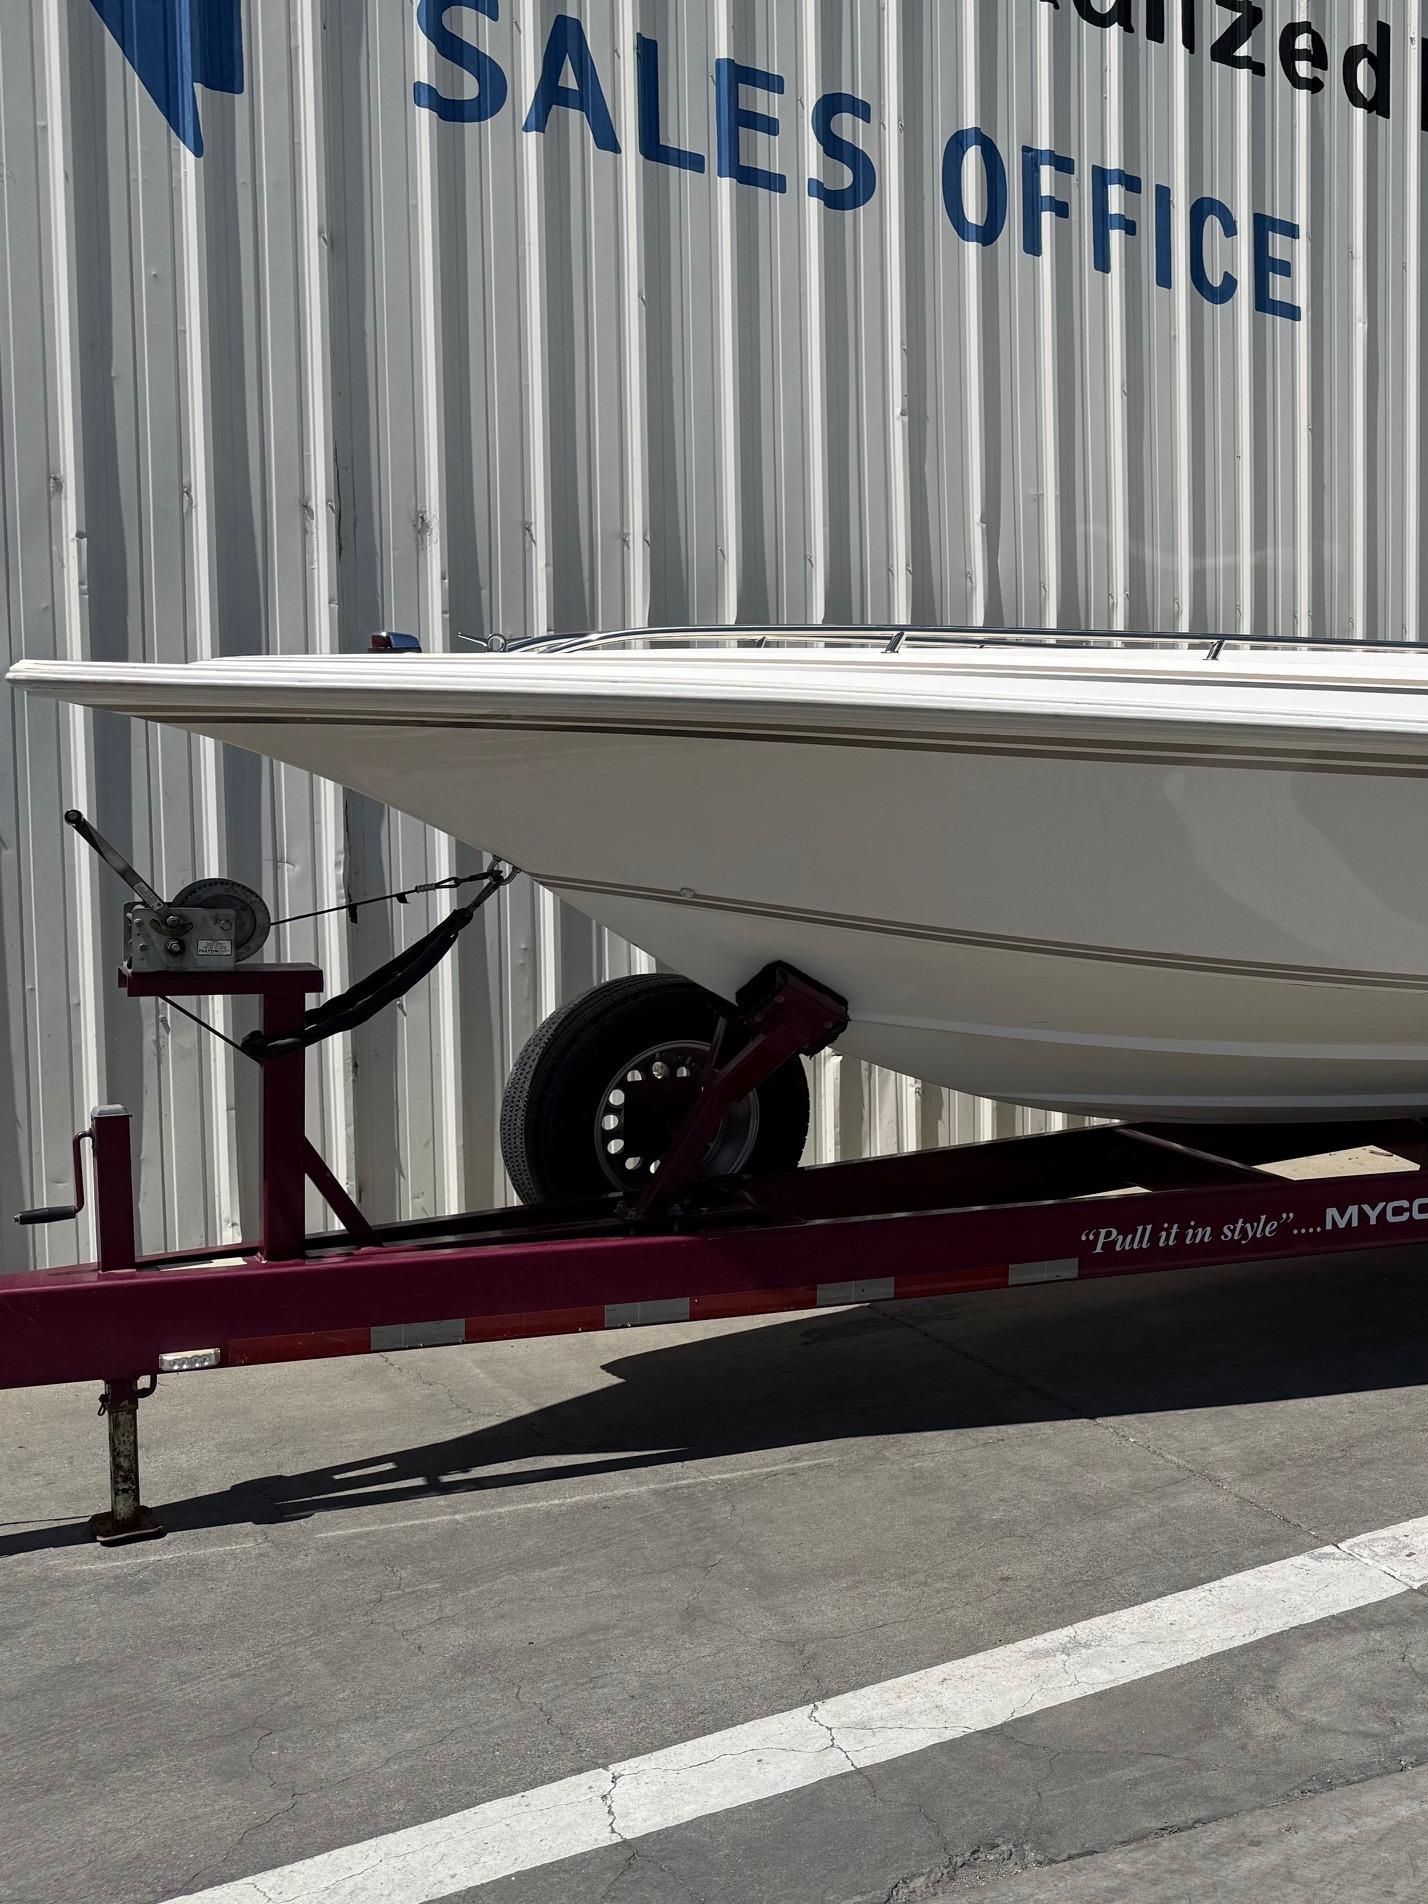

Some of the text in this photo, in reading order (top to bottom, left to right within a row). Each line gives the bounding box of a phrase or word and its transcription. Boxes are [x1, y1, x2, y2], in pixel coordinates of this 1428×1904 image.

[413, 0, 1302, 322] SALES OFFICE
[1158, 1222, 1180, 1247] it
[1184, 1220, 1212, 1245] in
